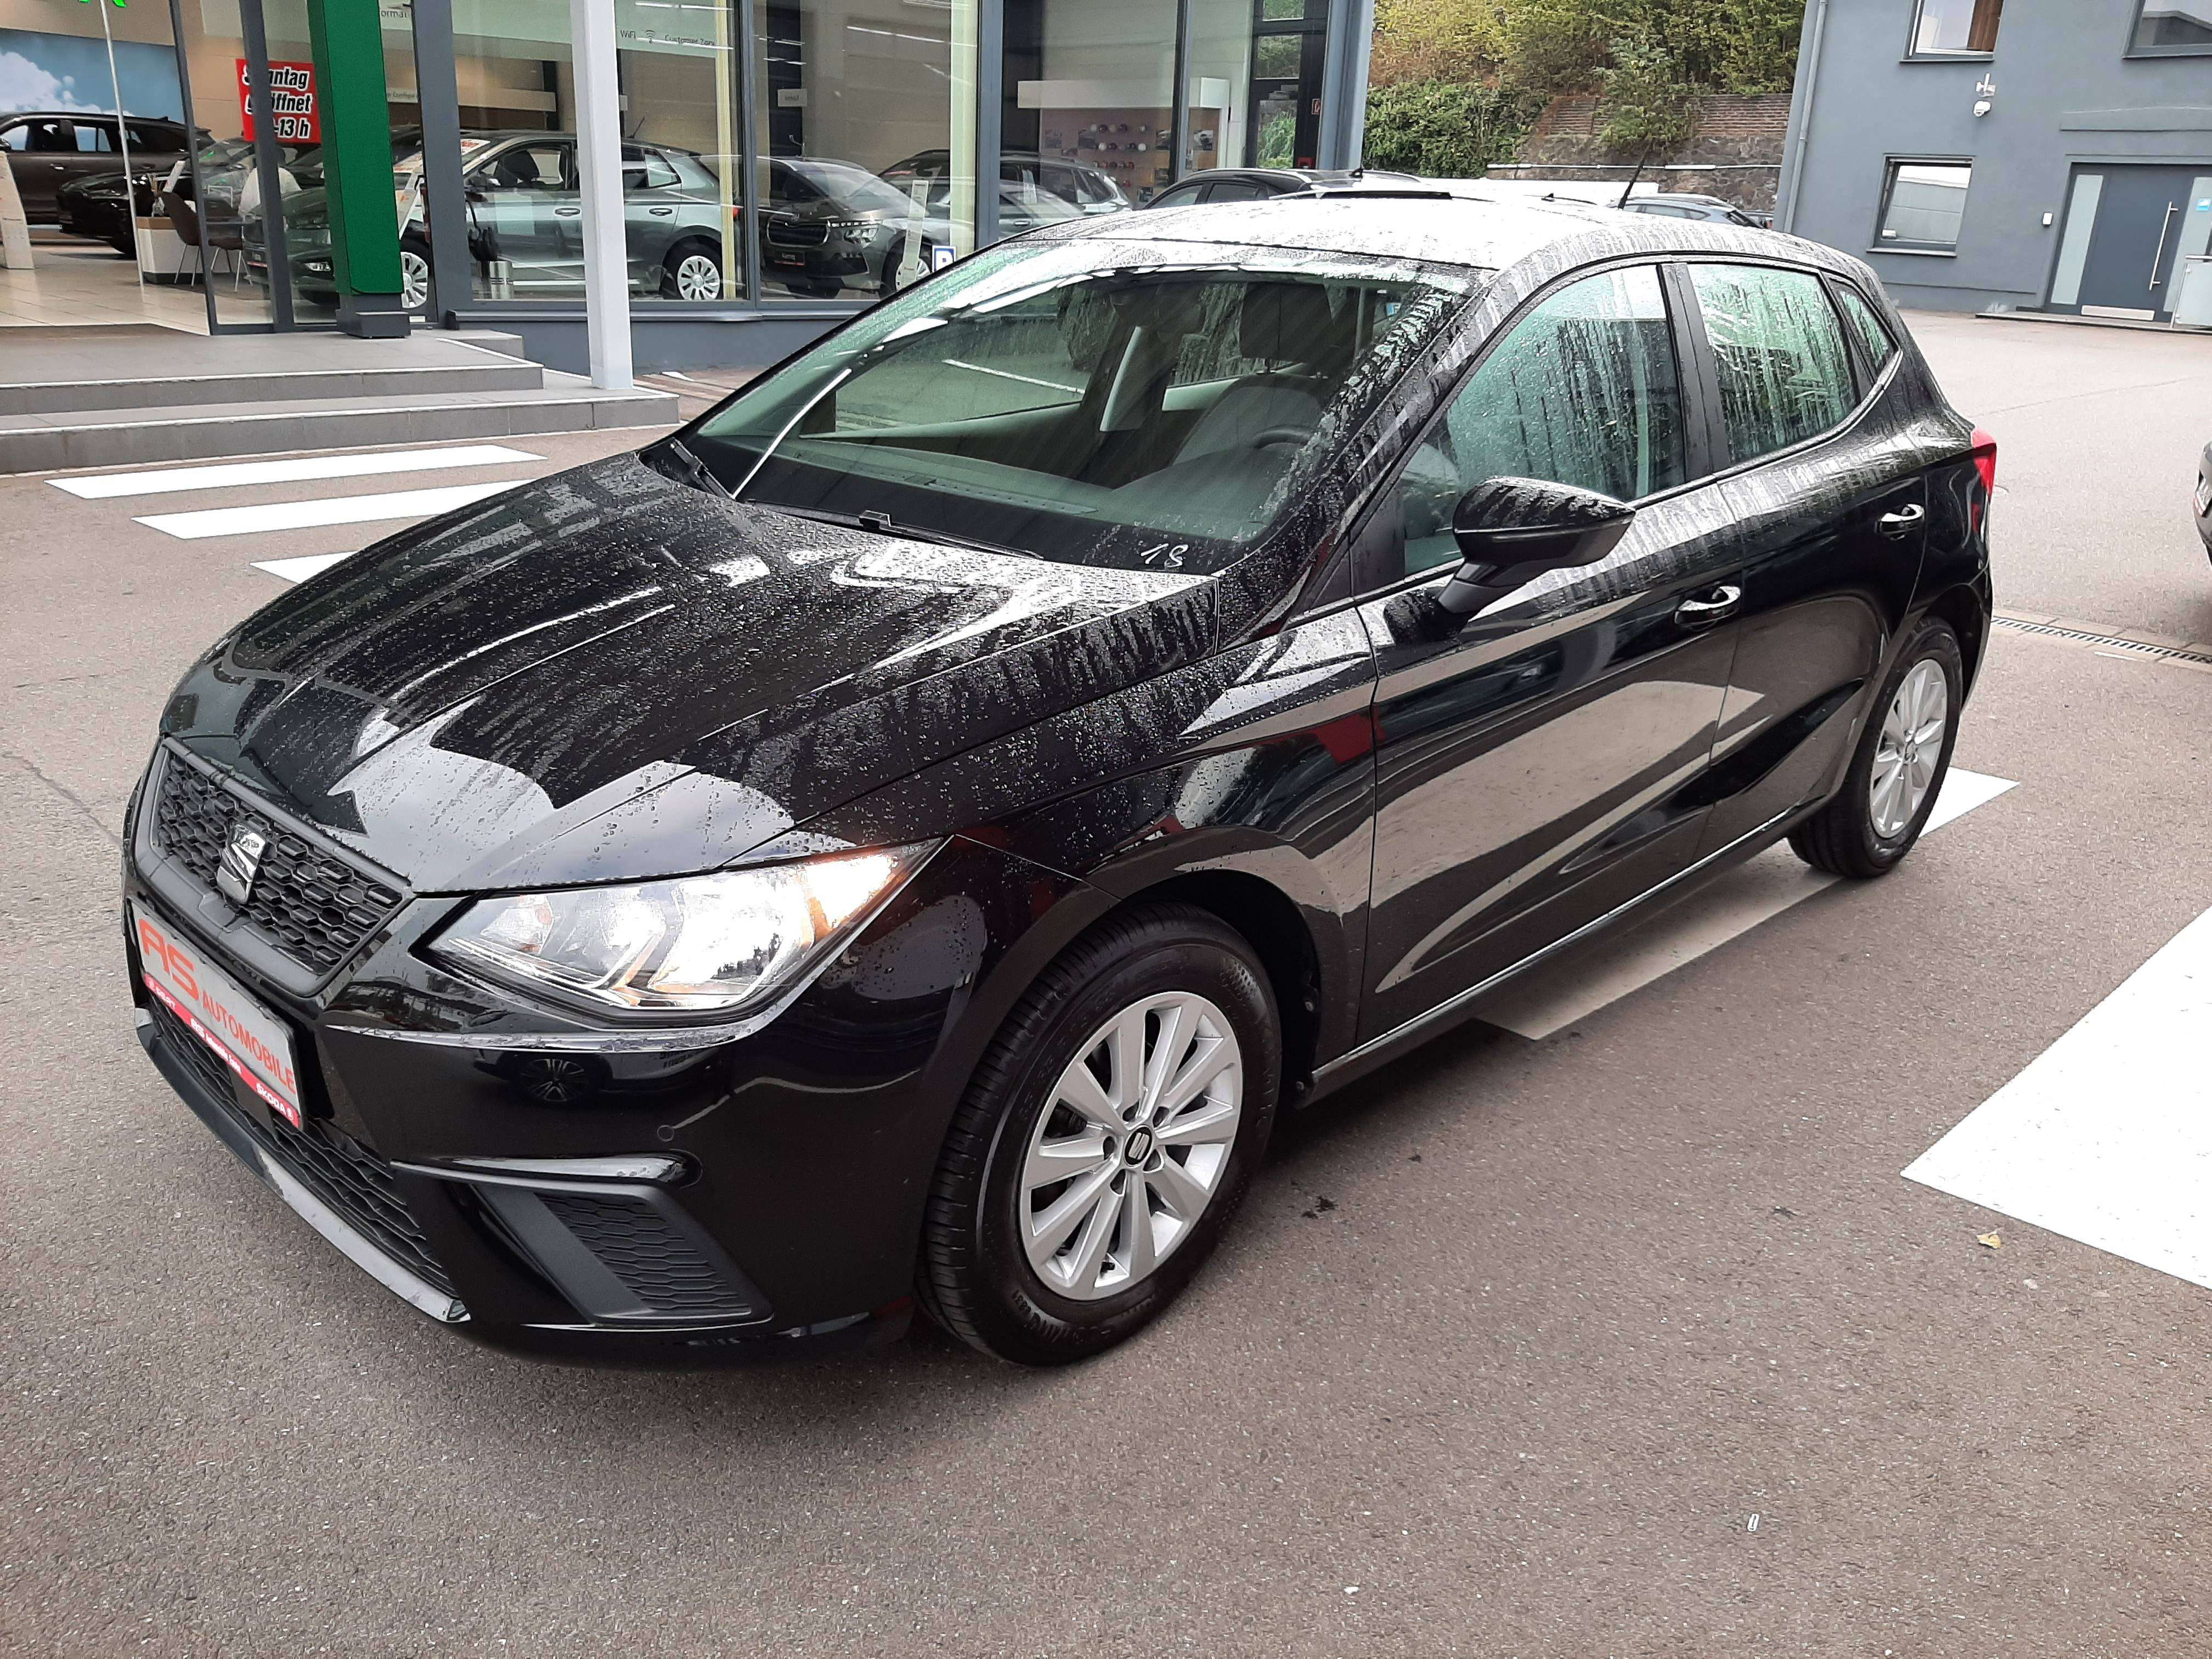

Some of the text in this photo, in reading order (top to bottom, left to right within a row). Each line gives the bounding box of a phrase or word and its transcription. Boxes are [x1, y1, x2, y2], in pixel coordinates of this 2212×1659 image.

[620, 30, 636, 39] WiFi
[297, 117, 311, 139] h
[138, 918, 297, 1095] AS AUTOMOBILE
